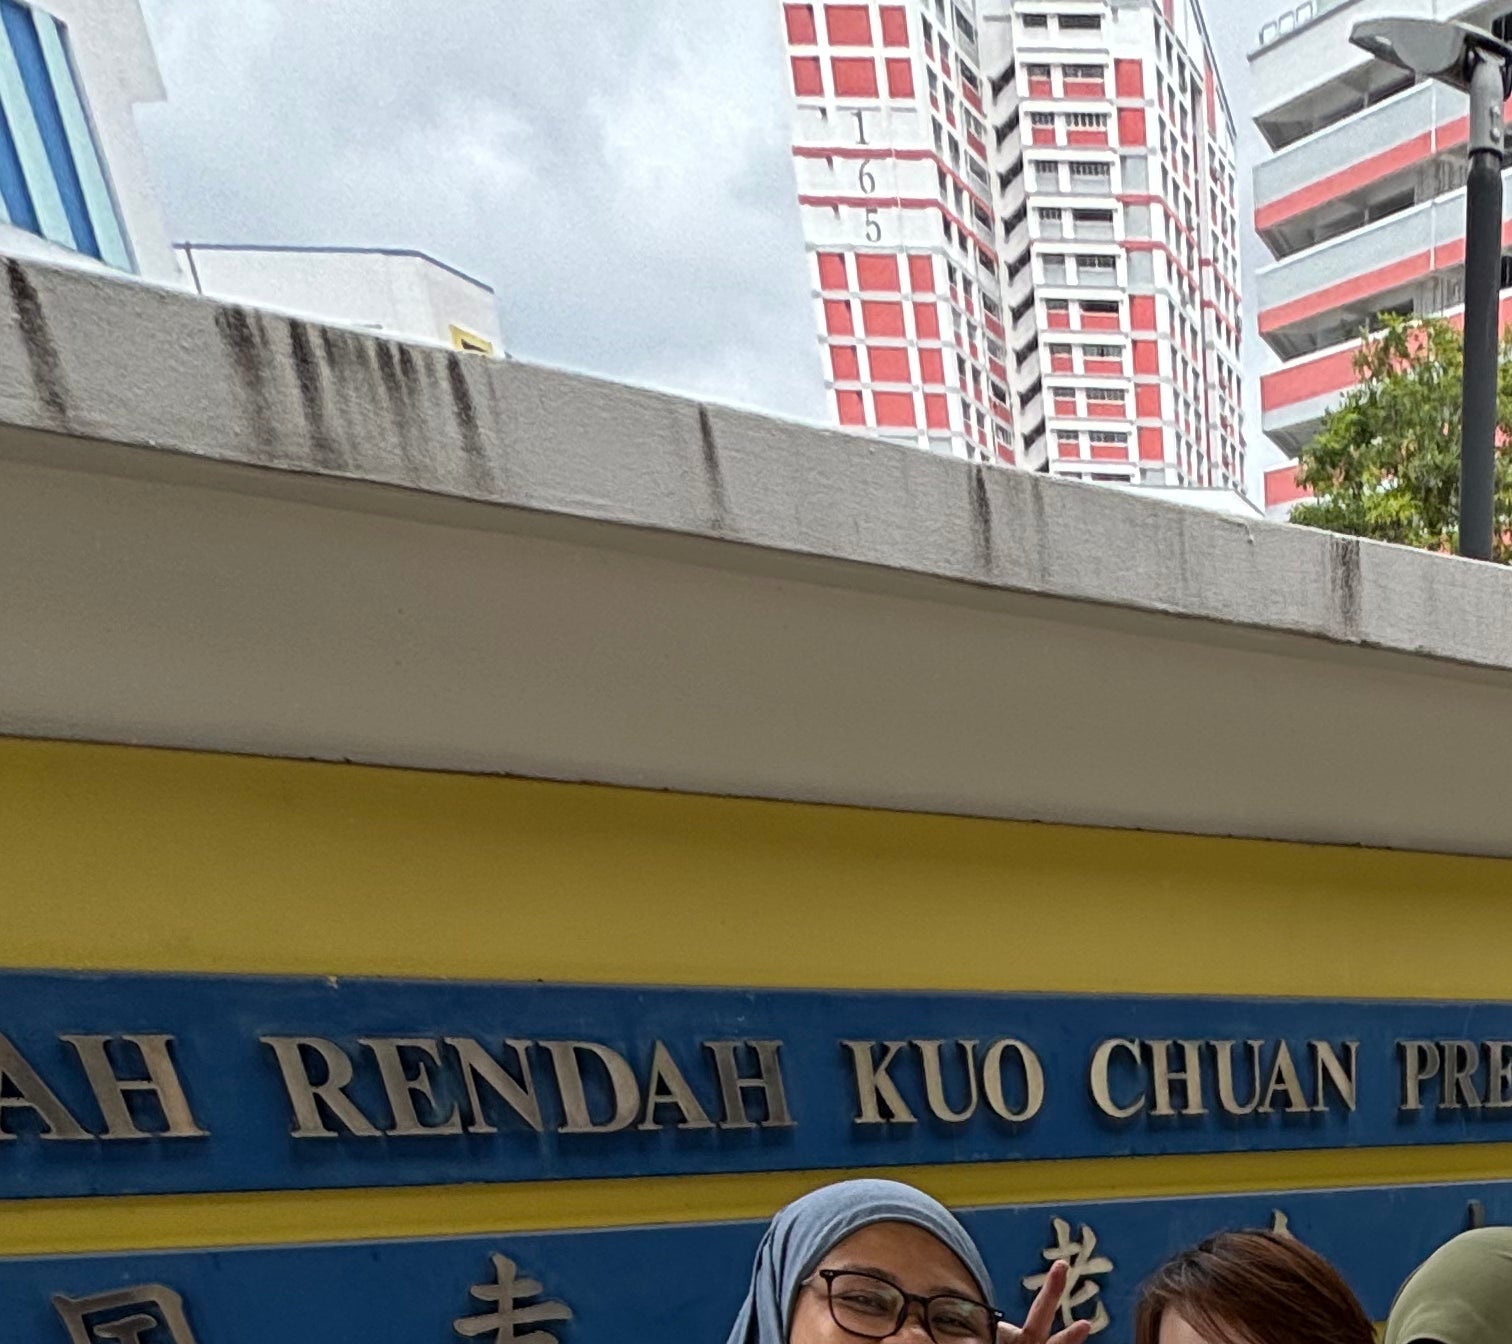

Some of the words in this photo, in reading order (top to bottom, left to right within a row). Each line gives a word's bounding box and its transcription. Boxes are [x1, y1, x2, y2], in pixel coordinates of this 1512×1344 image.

[260, 1034, 798, 1139] RENDAH
[842, 1037, 1047, 1126] KUO
[1089, 1037, 1361, 1120] CHUAN
